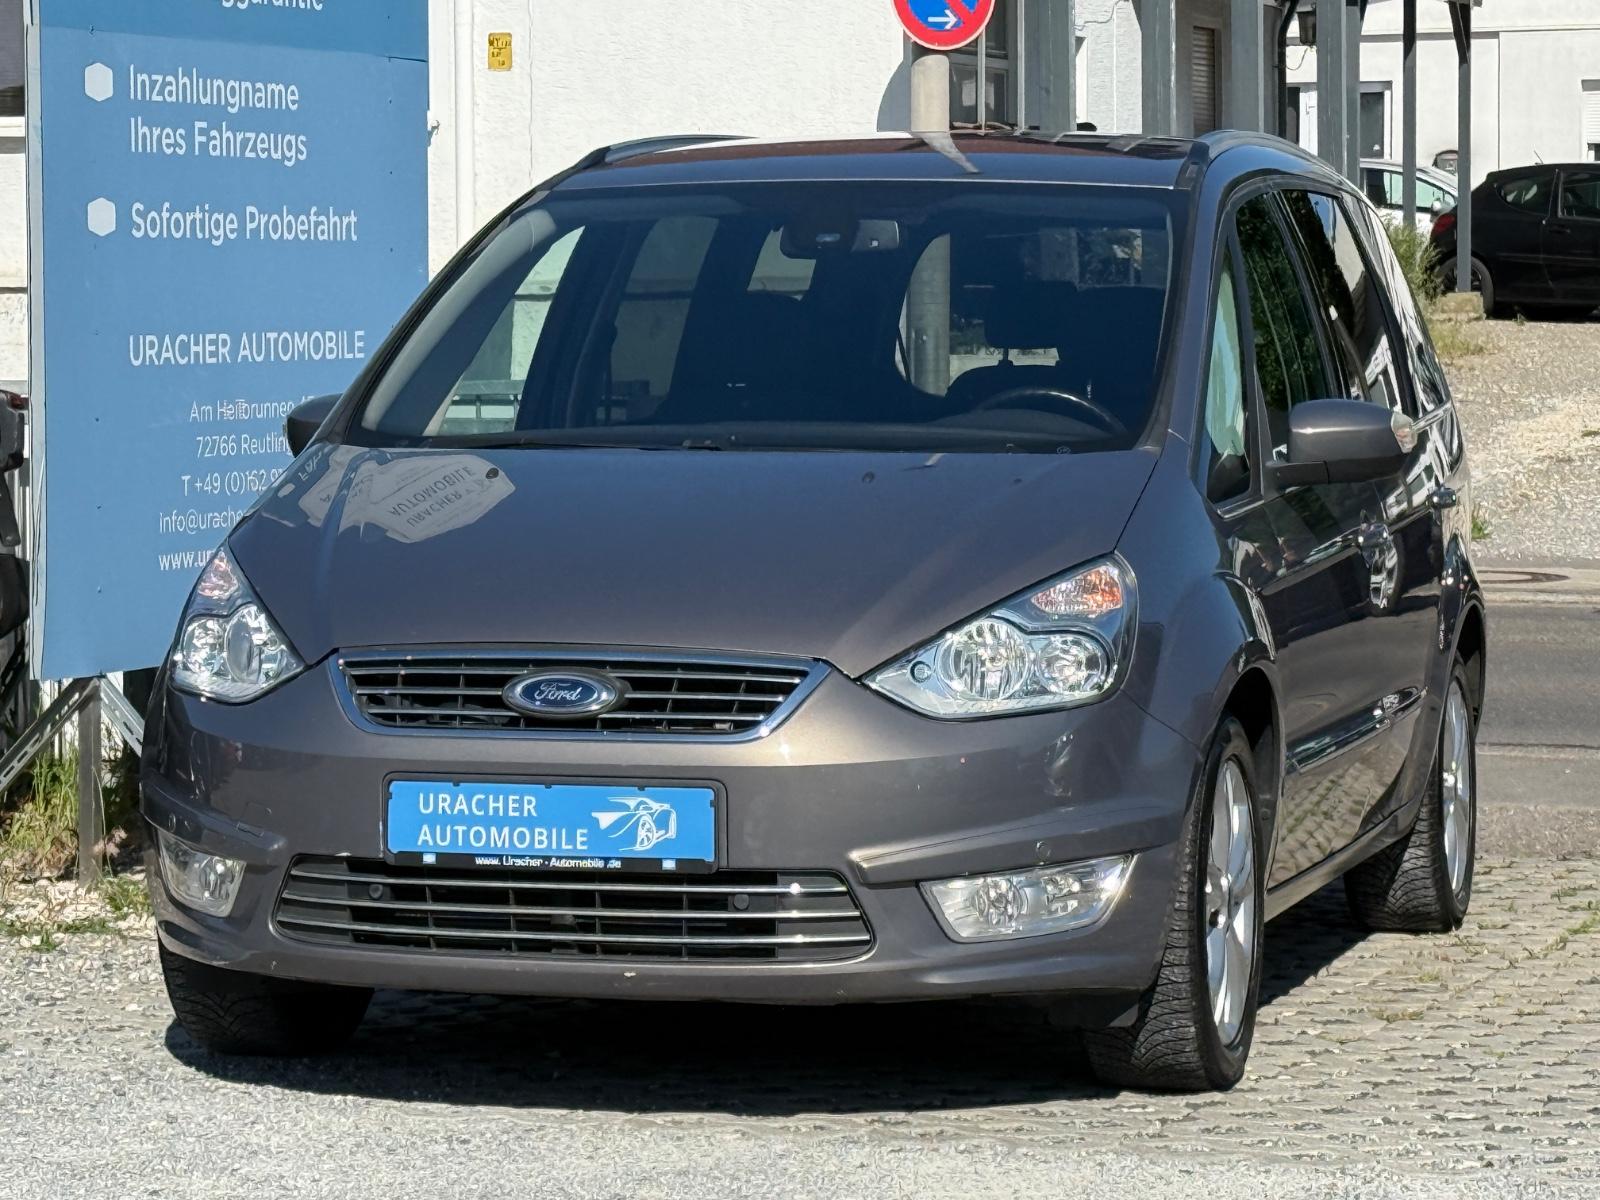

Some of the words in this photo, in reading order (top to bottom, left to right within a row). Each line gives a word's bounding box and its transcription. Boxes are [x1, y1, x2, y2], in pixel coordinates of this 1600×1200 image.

[129, 64, 299, 114] Inzahlungname
[130, 117, 186, 155] Ihres
[194, 121, 307, 167] Fahrzeugs
[131, 202, 238, 246] Sofortige
[246, 205, 358, 241] Probefahrt
[129, 333, 231, 366] URACHER
[237, 330, 365, 363] AUTOMOBILE
[189, 400, 212, 422] Am
[196, 434, 237, 459] 72766
[181, 475, 191, 497] T
[194, 472, 221, 495] +49
[534, 682, 582, 701] Ford
[418, 792, 538, 817] URACHER
[417, 823, 589, 851] AUTOMOBILE
